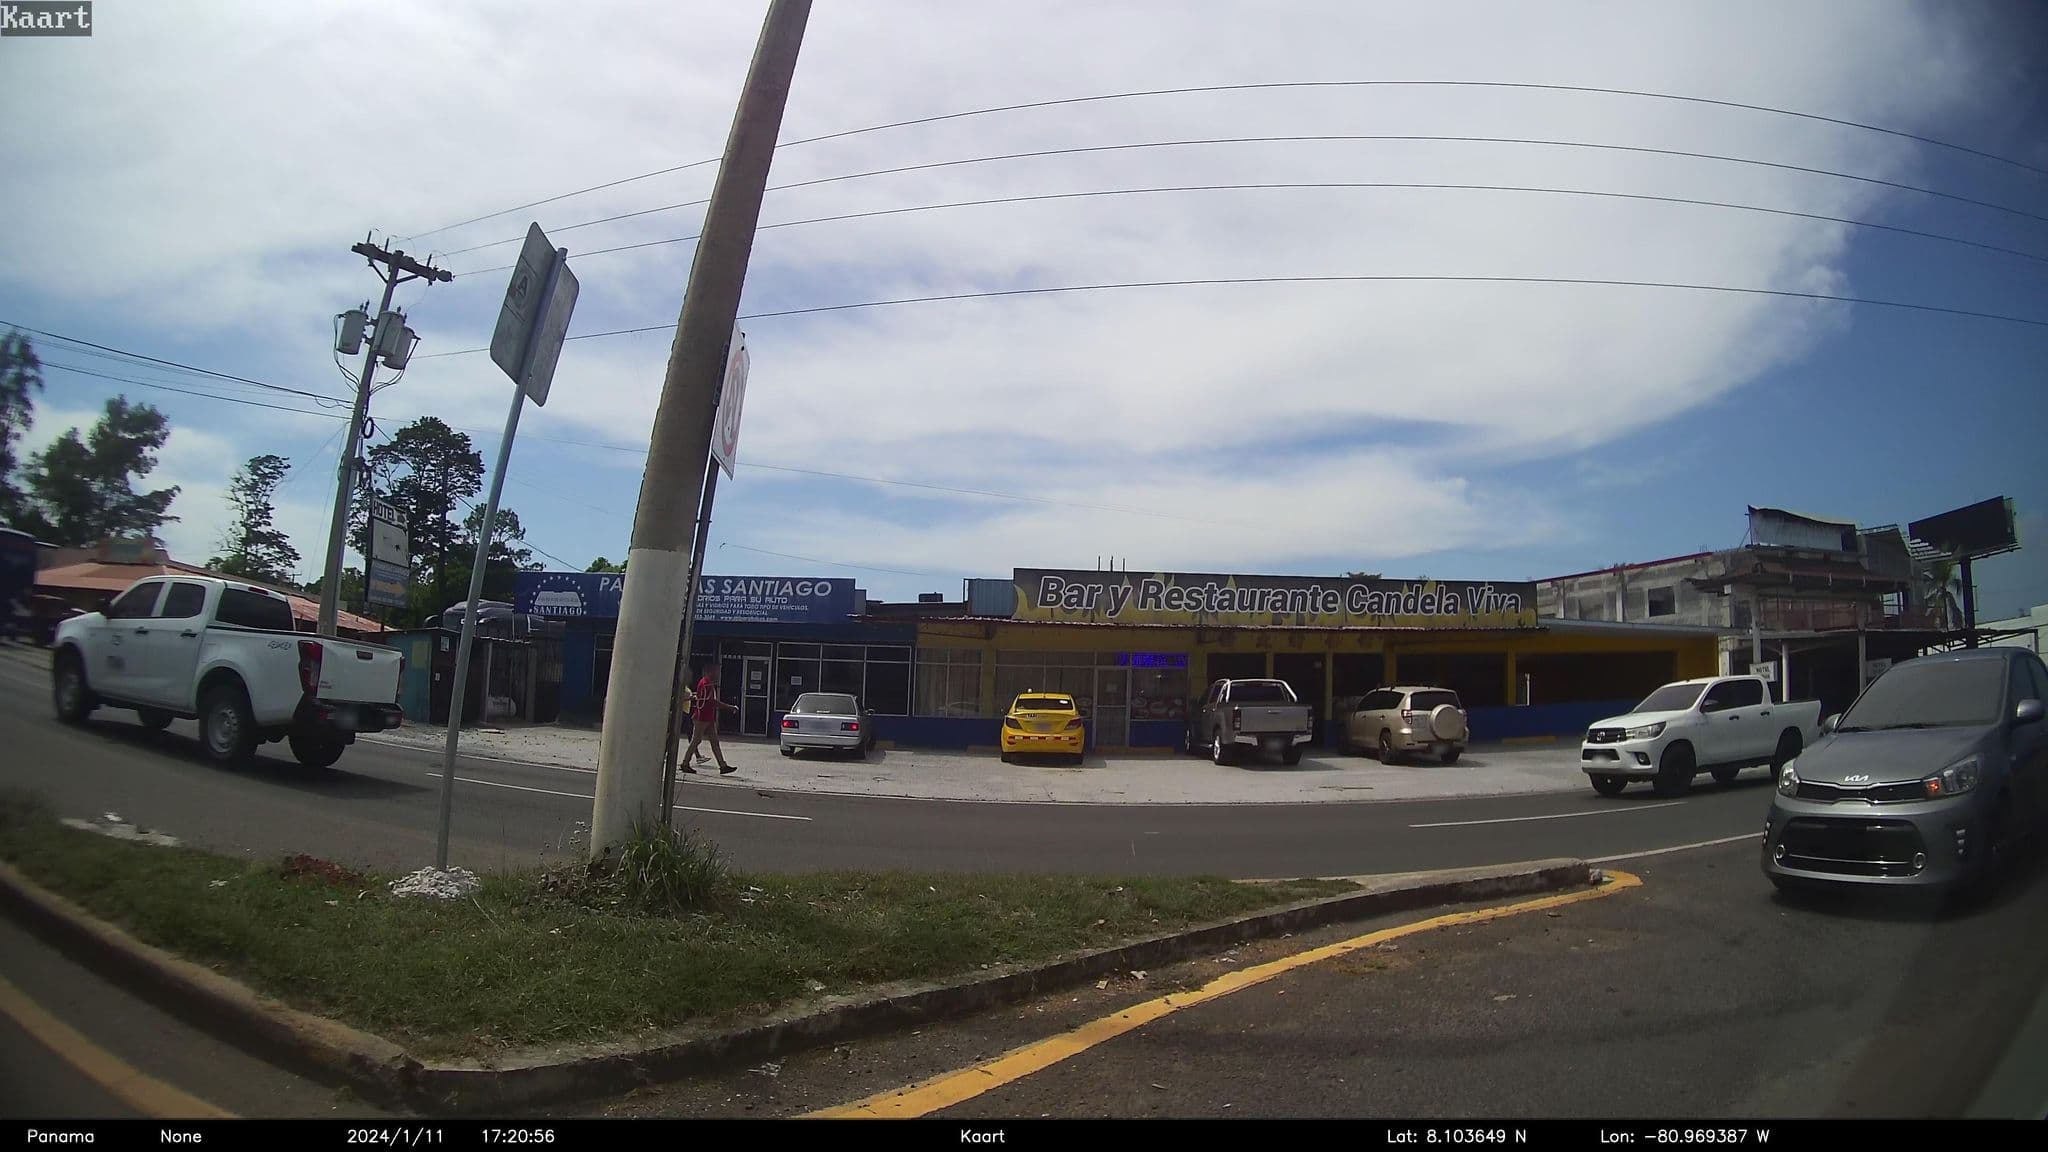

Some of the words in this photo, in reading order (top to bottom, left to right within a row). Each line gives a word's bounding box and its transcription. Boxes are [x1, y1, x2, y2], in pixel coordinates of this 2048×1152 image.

[721, 579, 832, 597] SANTIAGO
[723, 595, 747, 603] PARA
[1037, 575, 1103, 609] Bar
[1105, 584, 1134, 618] y
[1138, 578, 1340, 614] Restaurante
[1346, 584, 1461, 616] Candela
[1466, 585, 1522, 615] Viva
[533, 605, 583, 616] SANTIAGO
